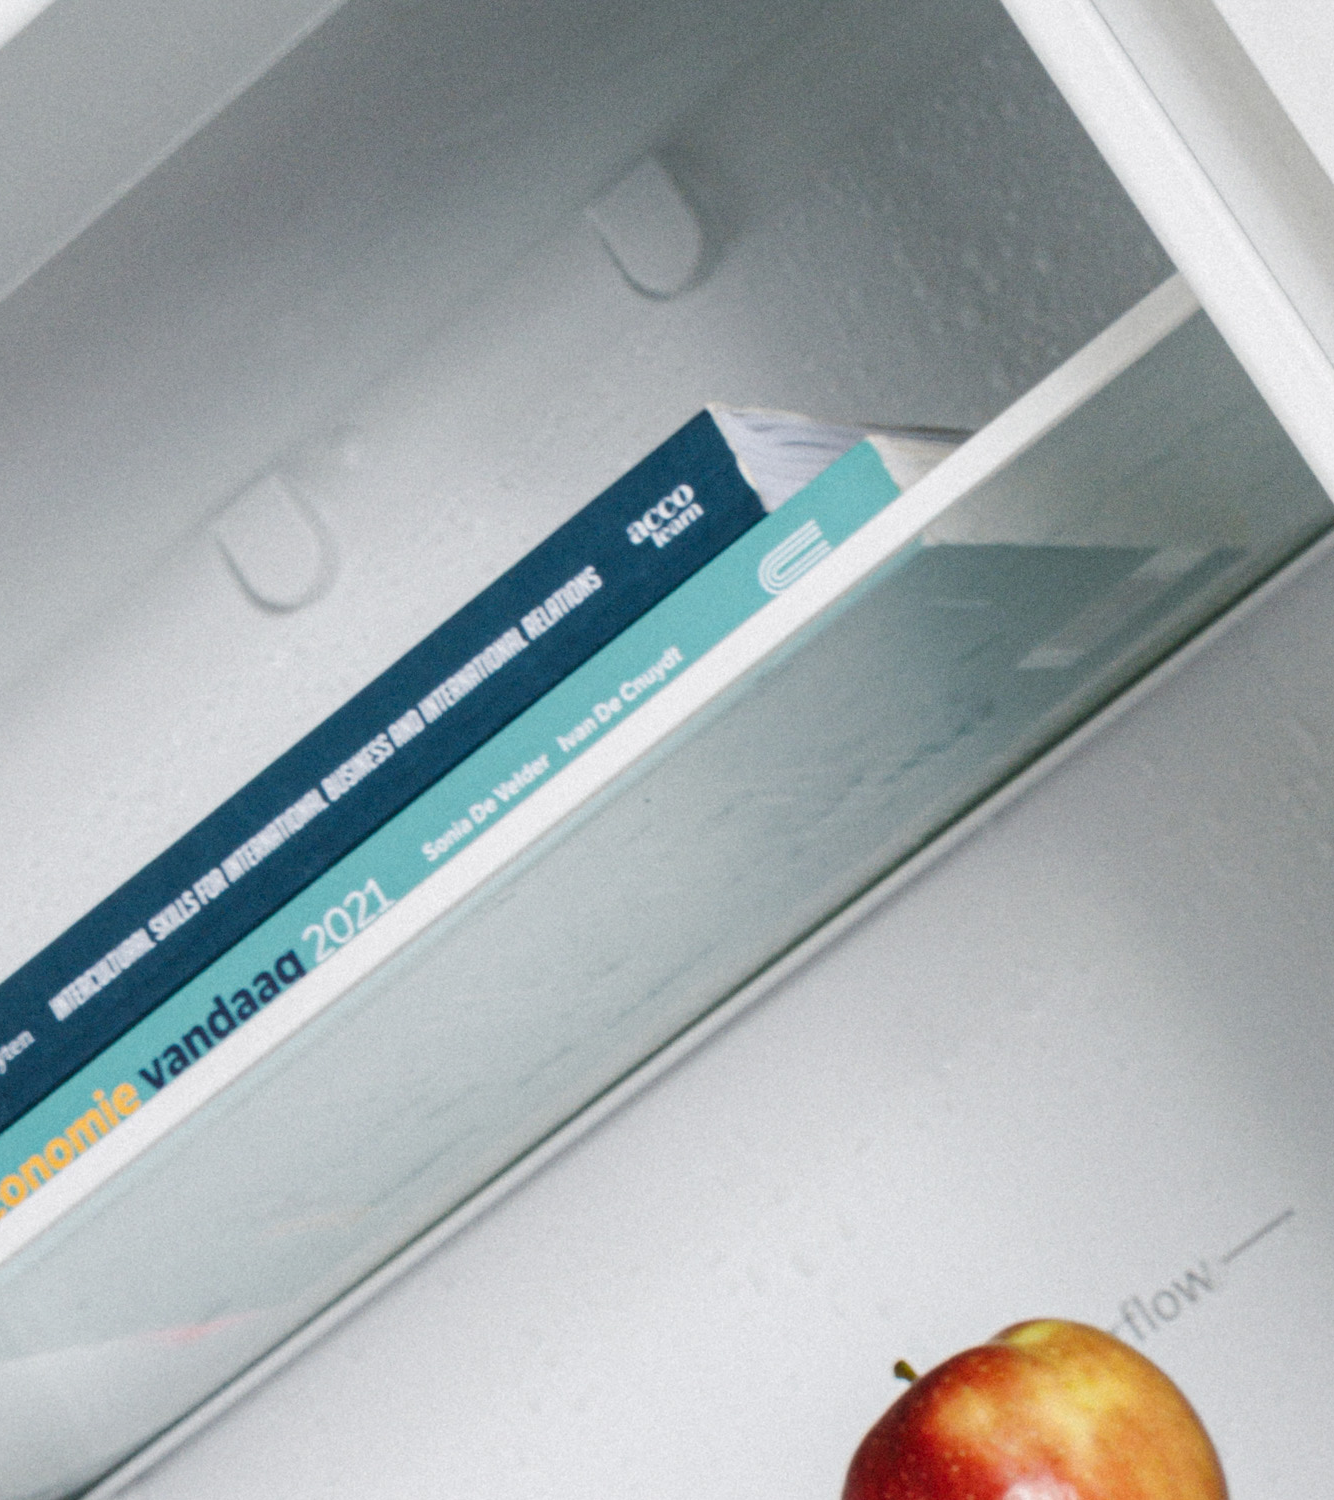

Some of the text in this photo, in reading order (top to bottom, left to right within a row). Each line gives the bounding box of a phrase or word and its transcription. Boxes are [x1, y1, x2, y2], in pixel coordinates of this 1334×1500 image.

[625, 483, 695, 546] acco
[649, 502, 705, 549] learn
[556, 645, 685, 754] Ivan De Cnuydt
[148, 889, 203, 942] SKILLS
[192, 867, 231, 905] FOR
[220, 788, 330, 883] INTERNATIONAL
[320, 733, 396, 803] BUSINESS
[387, 709, 427, 748] AND
[417, 626, 530, 724] INTERNATIONAL
[520, 565, 603, 642] RELATIONS
[422, 753, 551, 862] Sonia De Velder
[301, 878, 397, 964] 2021
[1113, 1260, 1215, 1341] flow
